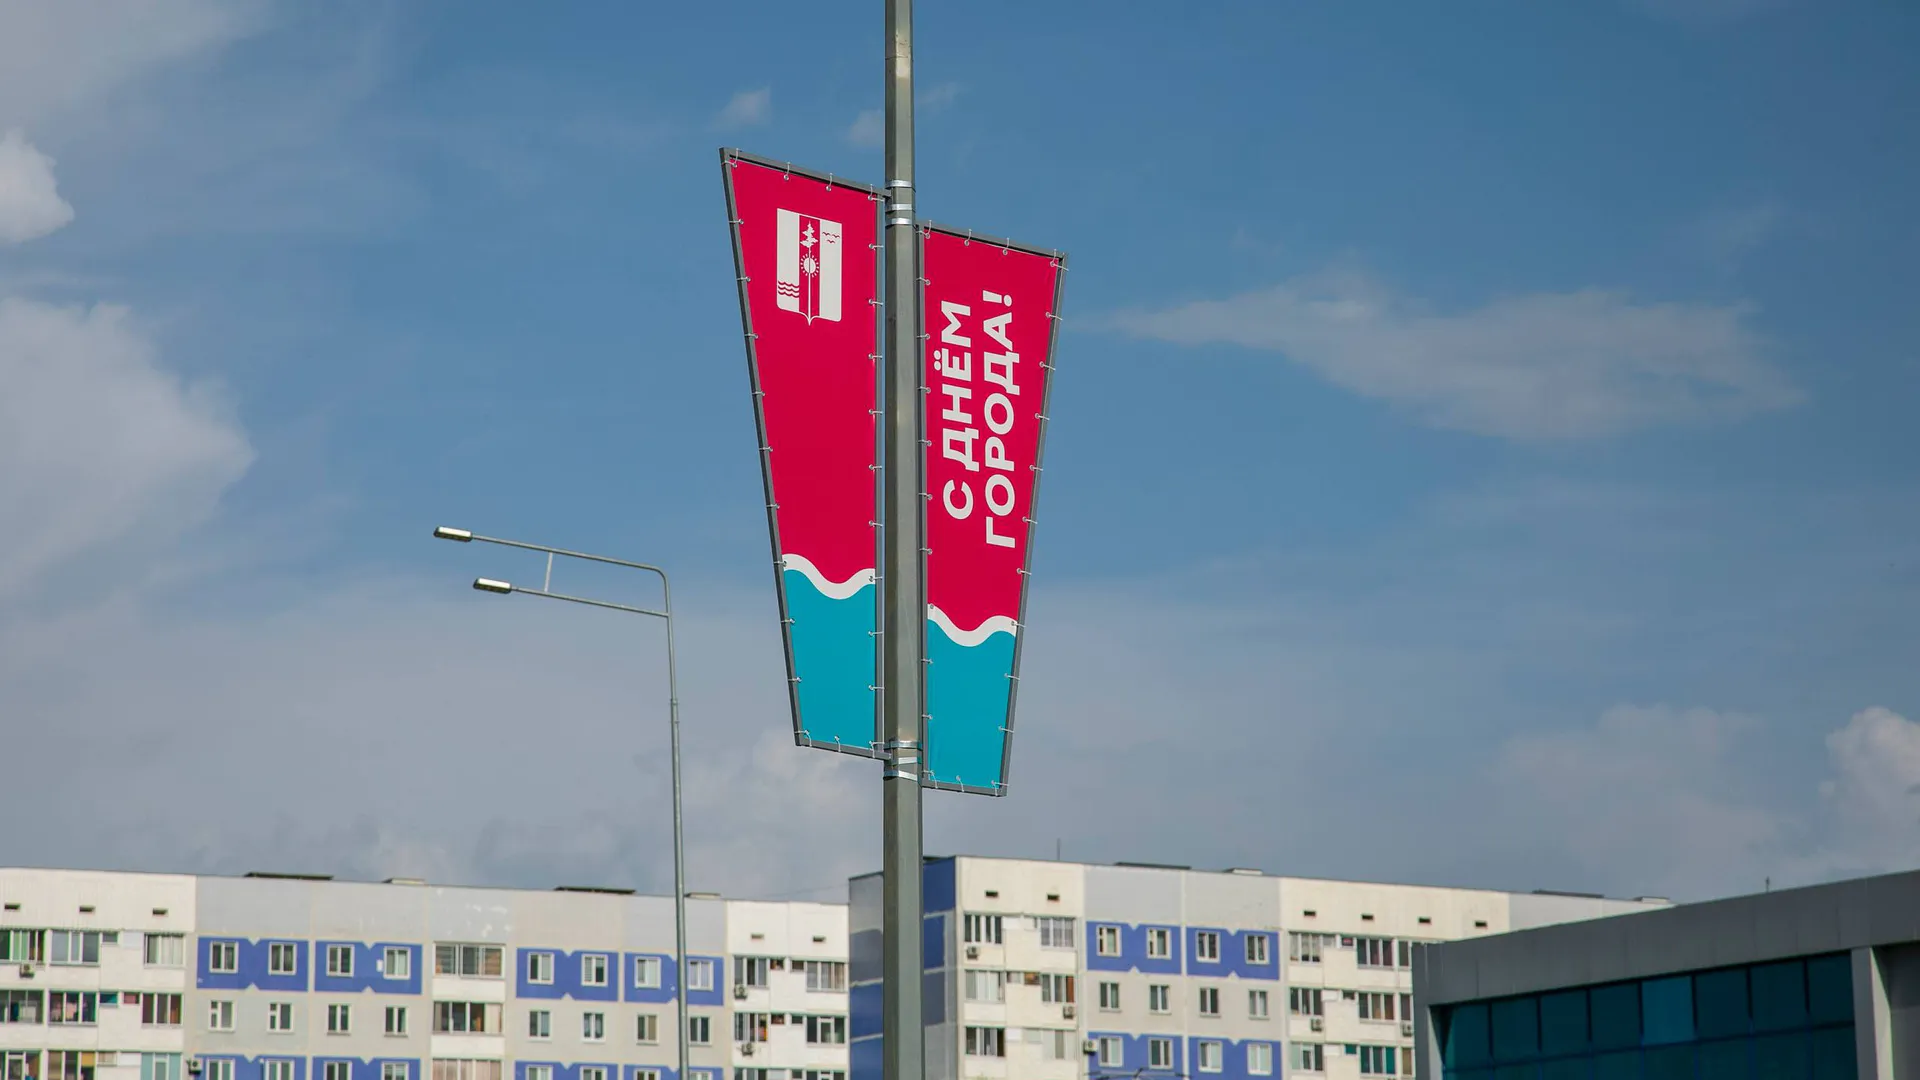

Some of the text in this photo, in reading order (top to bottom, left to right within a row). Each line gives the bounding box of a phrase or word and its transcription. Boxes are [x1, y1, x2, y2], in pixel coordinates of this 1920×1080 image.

[933, 300, 980, 520] С ДНЁМ
[982, 290, 1020, 548] ГОРОДА!
